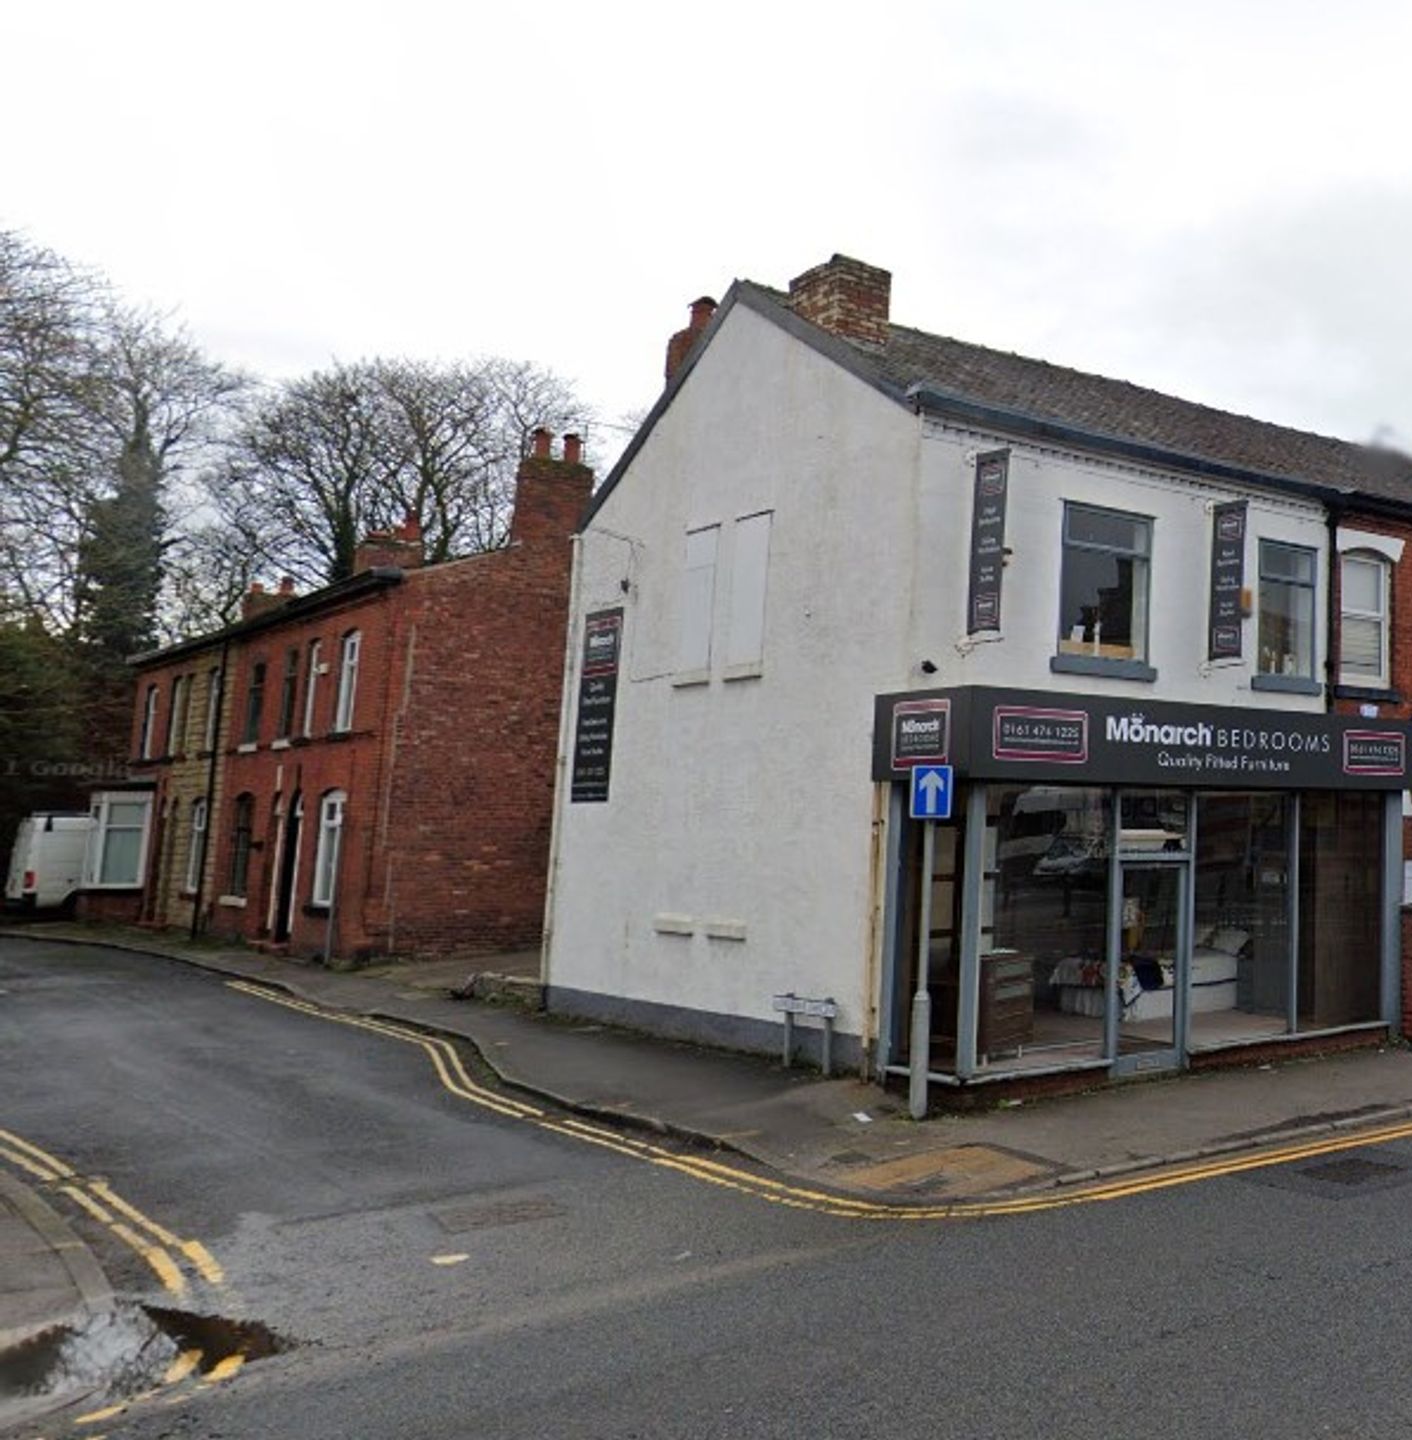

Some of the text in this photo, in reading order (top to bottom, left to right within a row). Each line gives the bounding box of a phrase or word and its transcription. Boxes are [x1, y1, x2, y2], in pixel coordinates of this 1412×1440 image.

[1217, 729, 1331, 752] BEDROOMS
[1158, 751, 1290, 771] Quality Fitted Furniture
